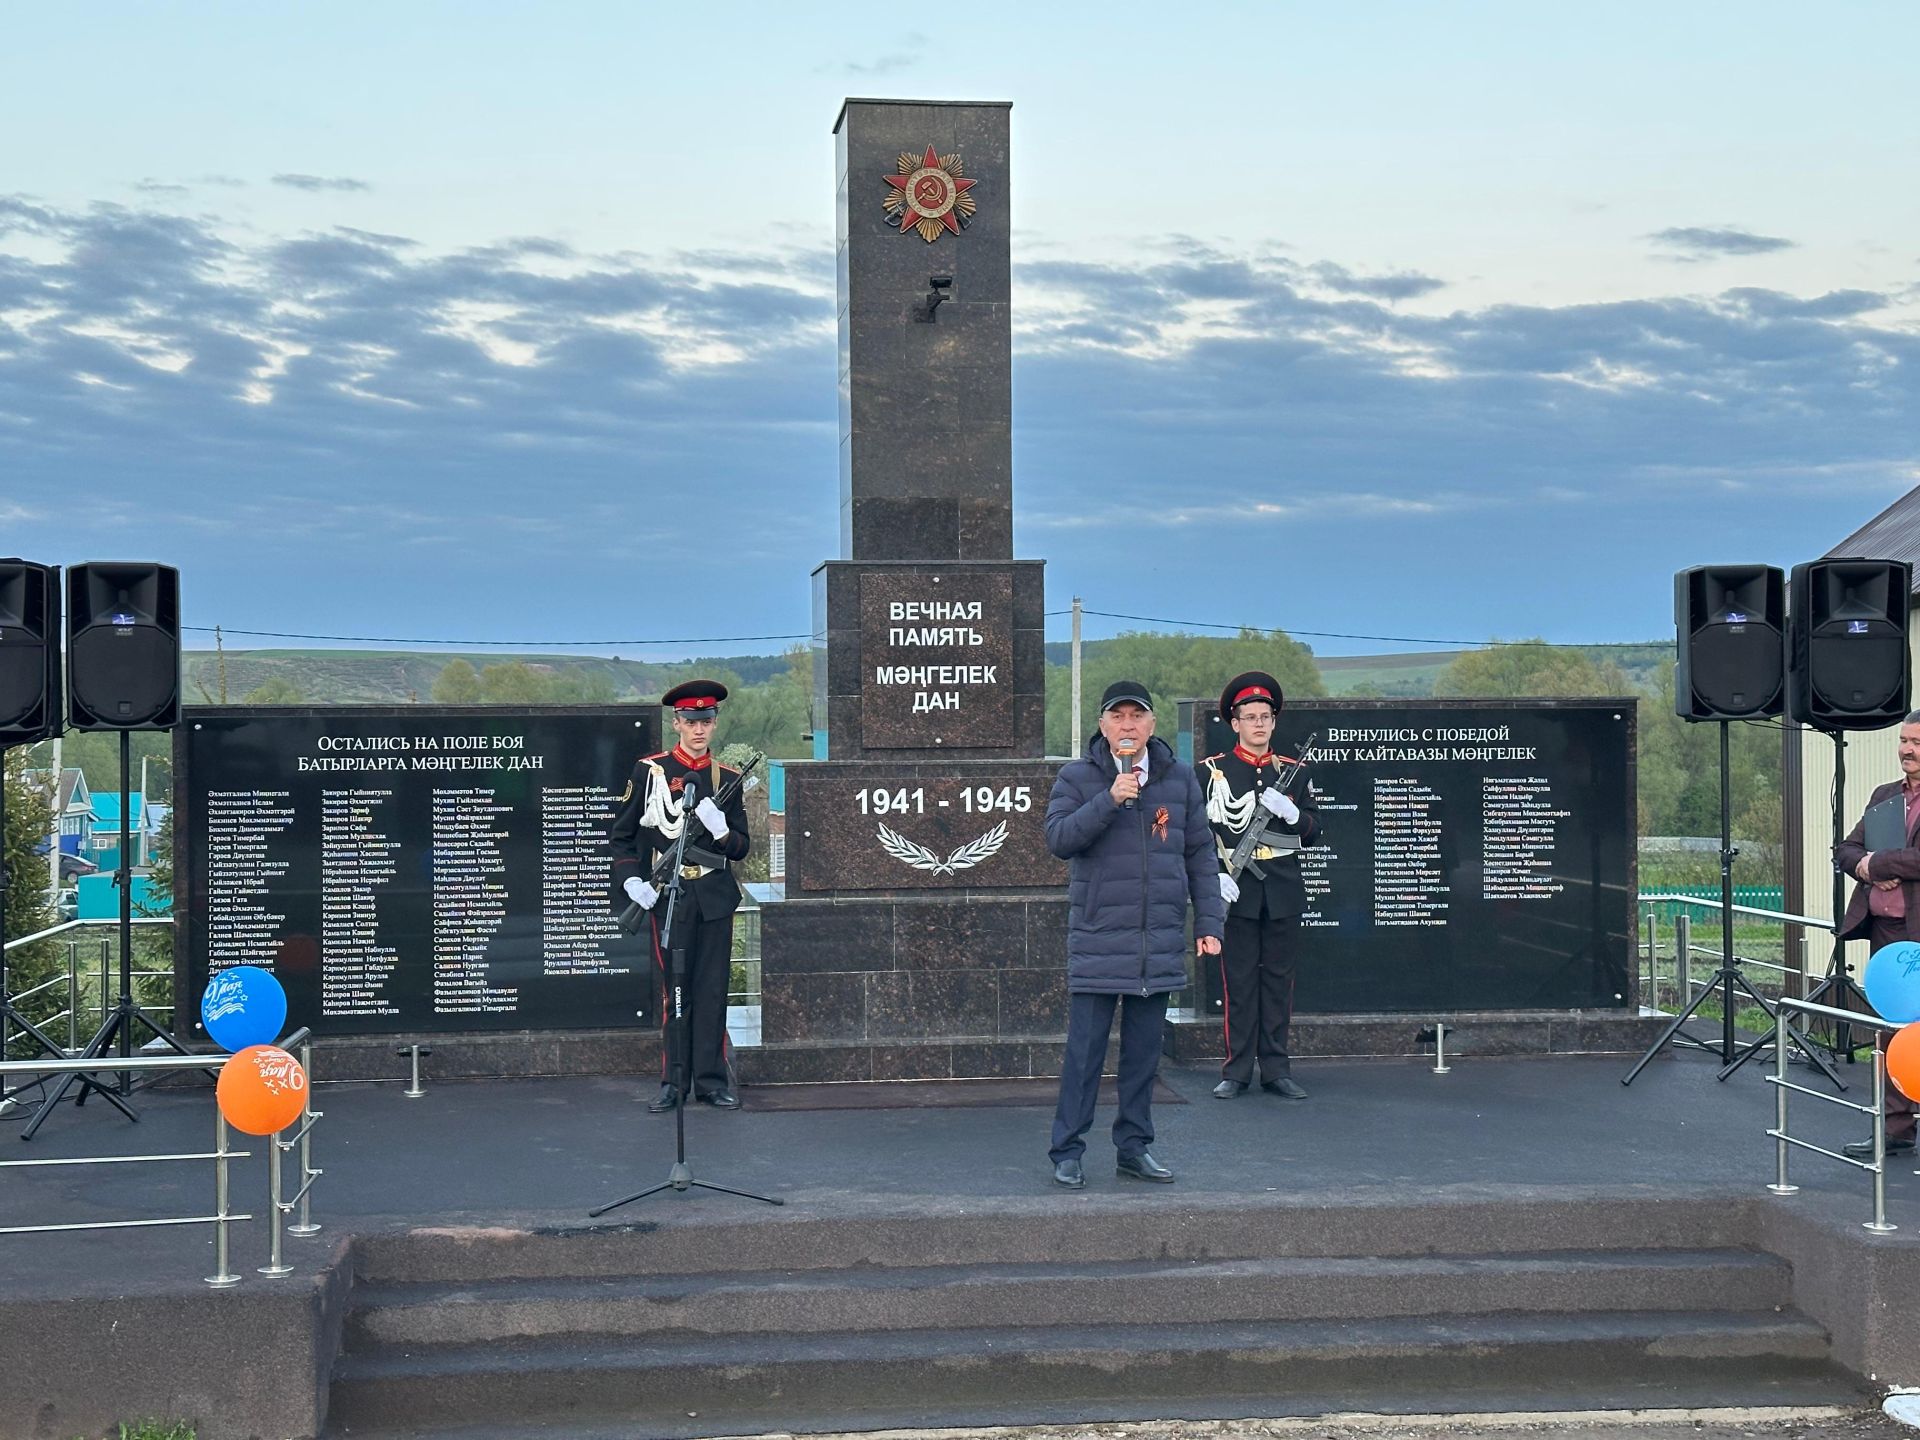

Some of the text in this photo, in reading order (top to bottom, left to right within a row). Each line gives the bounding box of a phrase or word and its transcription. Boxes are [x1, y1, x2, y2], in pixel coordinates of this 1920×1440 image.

[890, 602, 982, 620] ВЕЧНАЯ
[889, 628, 984, 646] ПАМЯТЬ
[876, 666, 997, 687] МӘҢГЕЛЕК
[912, 692, 960, 713] ДАН
[317, 736, 525, 750] ОСТАЛИСЬ НА ПОЛЕ БОЯ
[1328, 725, 1510, 743] ВЕРНУЛИСЬ С ПОБЕДОЙ
[1354, 746, 1448, 761] КАЙТАВАЗЫ
[1451, 747, 1537, 762] МӘҢГЕЛЕК
[298, 756, 544, 772] БАТЫРЛАРГА МӘҢГЕЛЕК ДАН
[855, 788, 924, 815] 1941
[959, 786, 1032, 813] 1945
